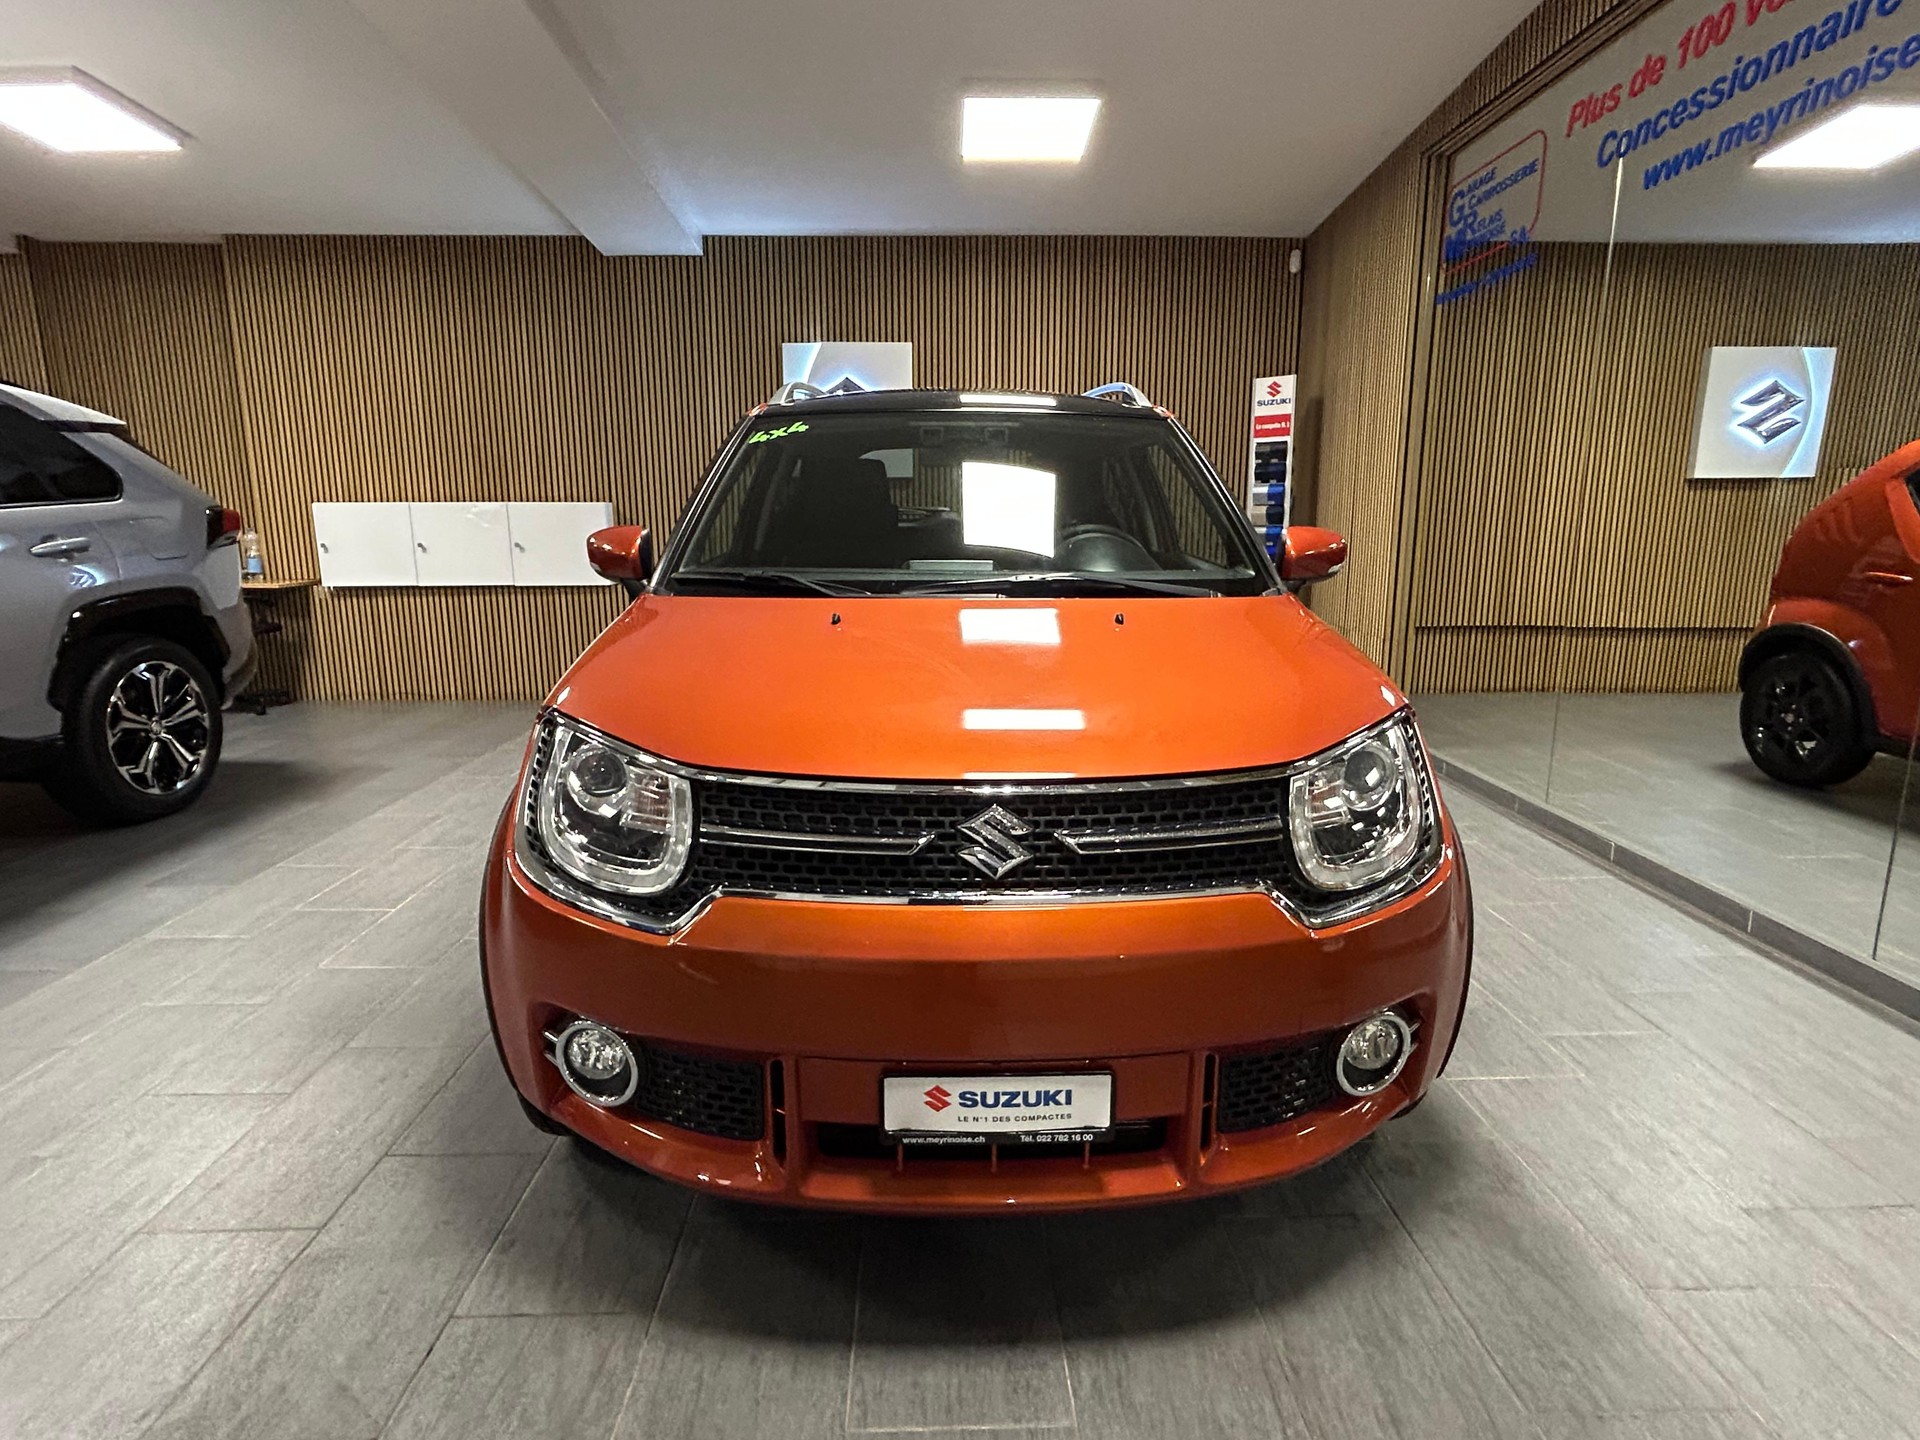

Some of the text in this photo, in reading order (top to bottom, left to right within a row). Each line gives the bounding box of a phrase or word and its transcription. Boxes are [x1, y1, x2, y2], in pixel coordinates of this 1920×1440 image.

[1565, 83, 1623, 138] Plus
[1628, 54, 1667, 98] de
[1678, 2, 1736, 69] 100
[1257, 398, 1291, 406] SUZUKI
[958, 1089, 1073, 1108] SUZUKI
[1014, 1113, 1072, 1122] COMPACTES
[902, 1135, 986, 1144] www.meyrinoise.ch
[1054, 1134, 1069, 1142] 782
[1082, 1133, 1094, 1141] 00
